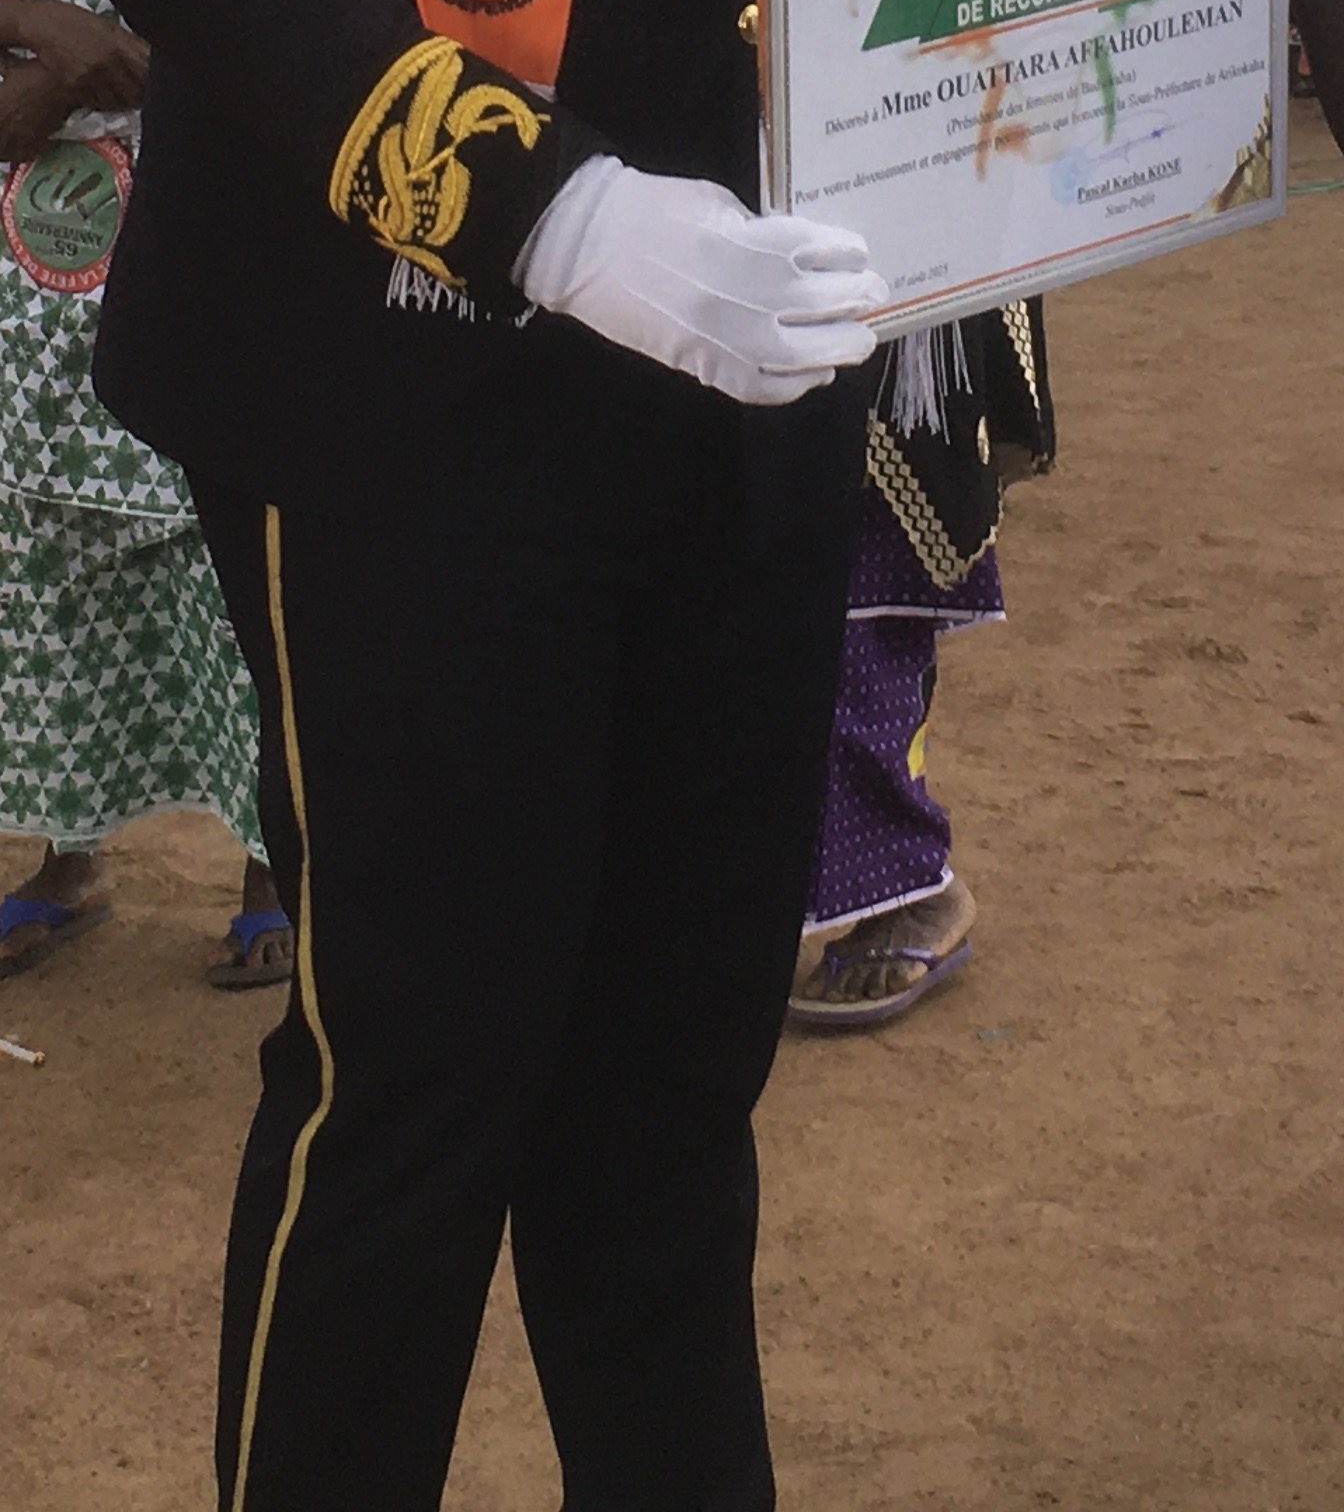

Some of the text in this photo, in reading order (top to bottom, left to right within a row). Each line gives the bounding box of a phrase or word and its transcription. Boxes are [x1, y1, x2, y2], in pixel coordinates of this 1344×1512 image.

[880, 88, 933, 121] Mme
[936, 50, 1061, 103] OUATTARA
[53, 240, 79, 258] 65
